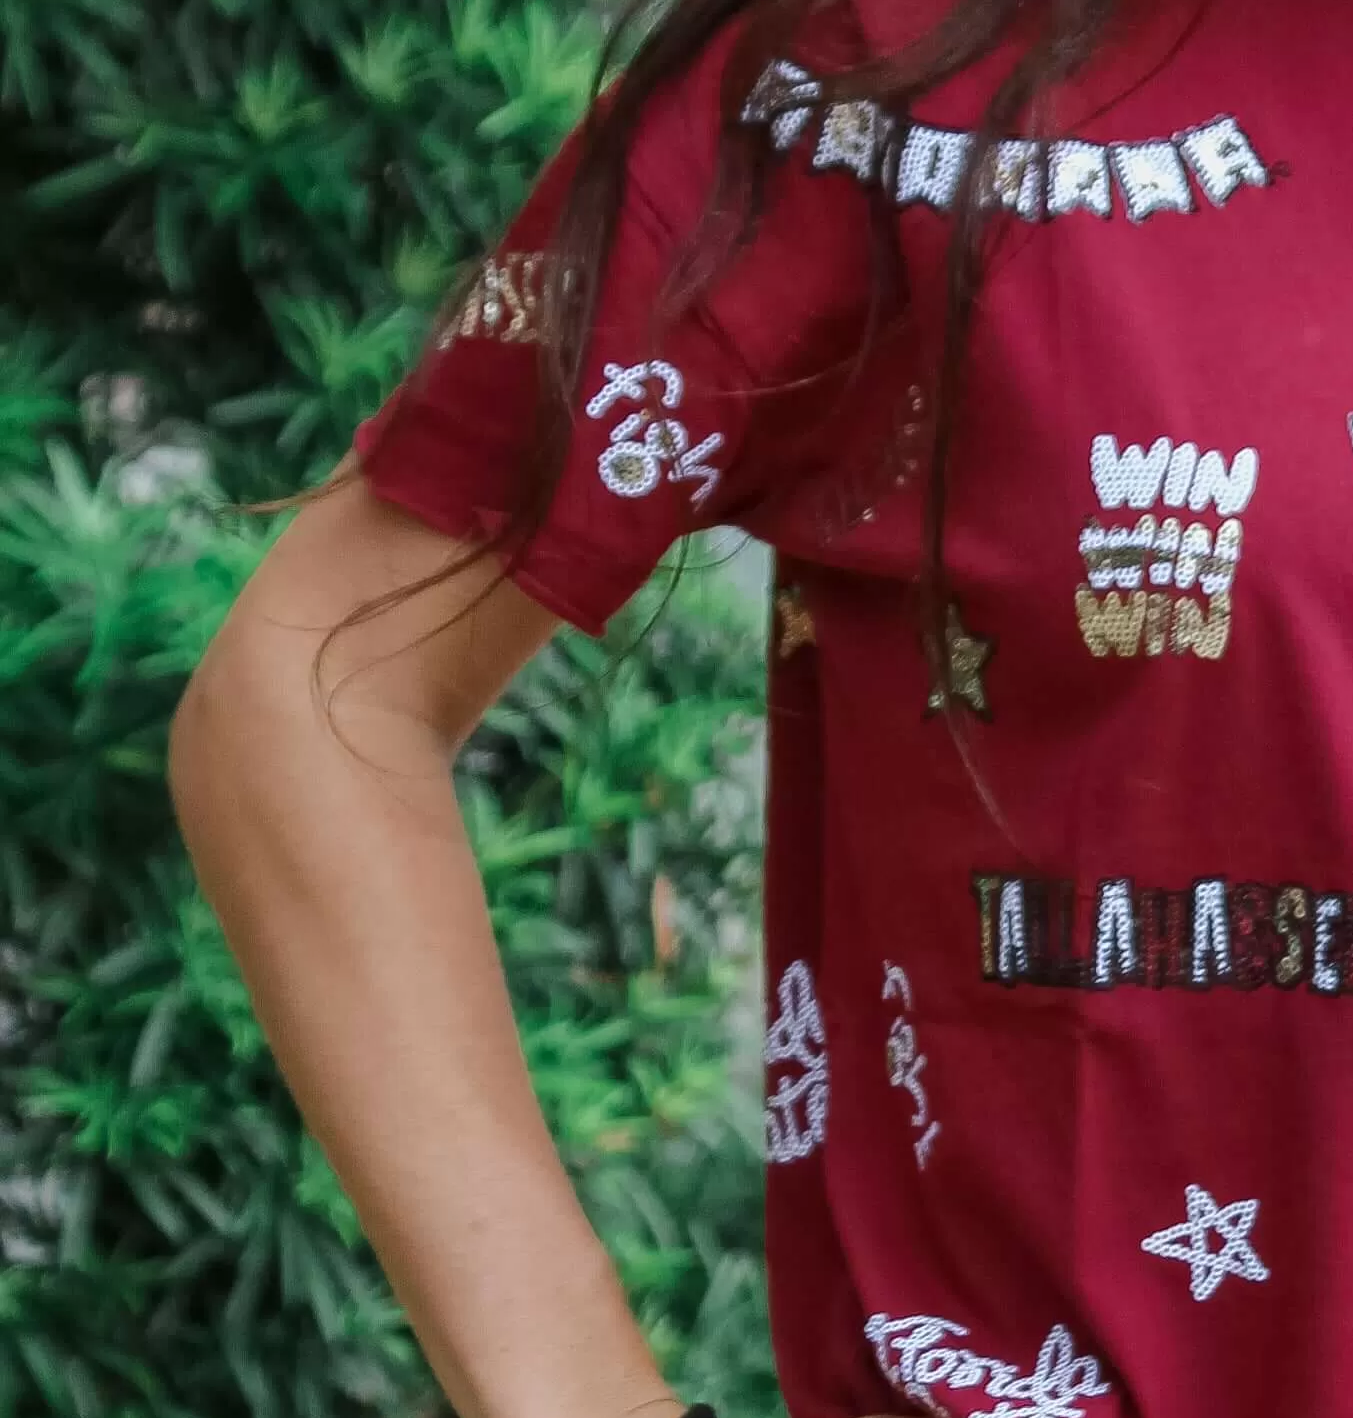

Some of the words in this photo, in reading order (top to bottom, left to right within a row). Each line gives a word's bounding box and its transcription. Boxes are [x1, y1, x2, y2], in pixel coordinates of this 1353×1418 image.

[586, 359, 724, 512] figh
[1089, 433, 1261, 516] WIN
[1074, 582, 1233, 661] WIN
